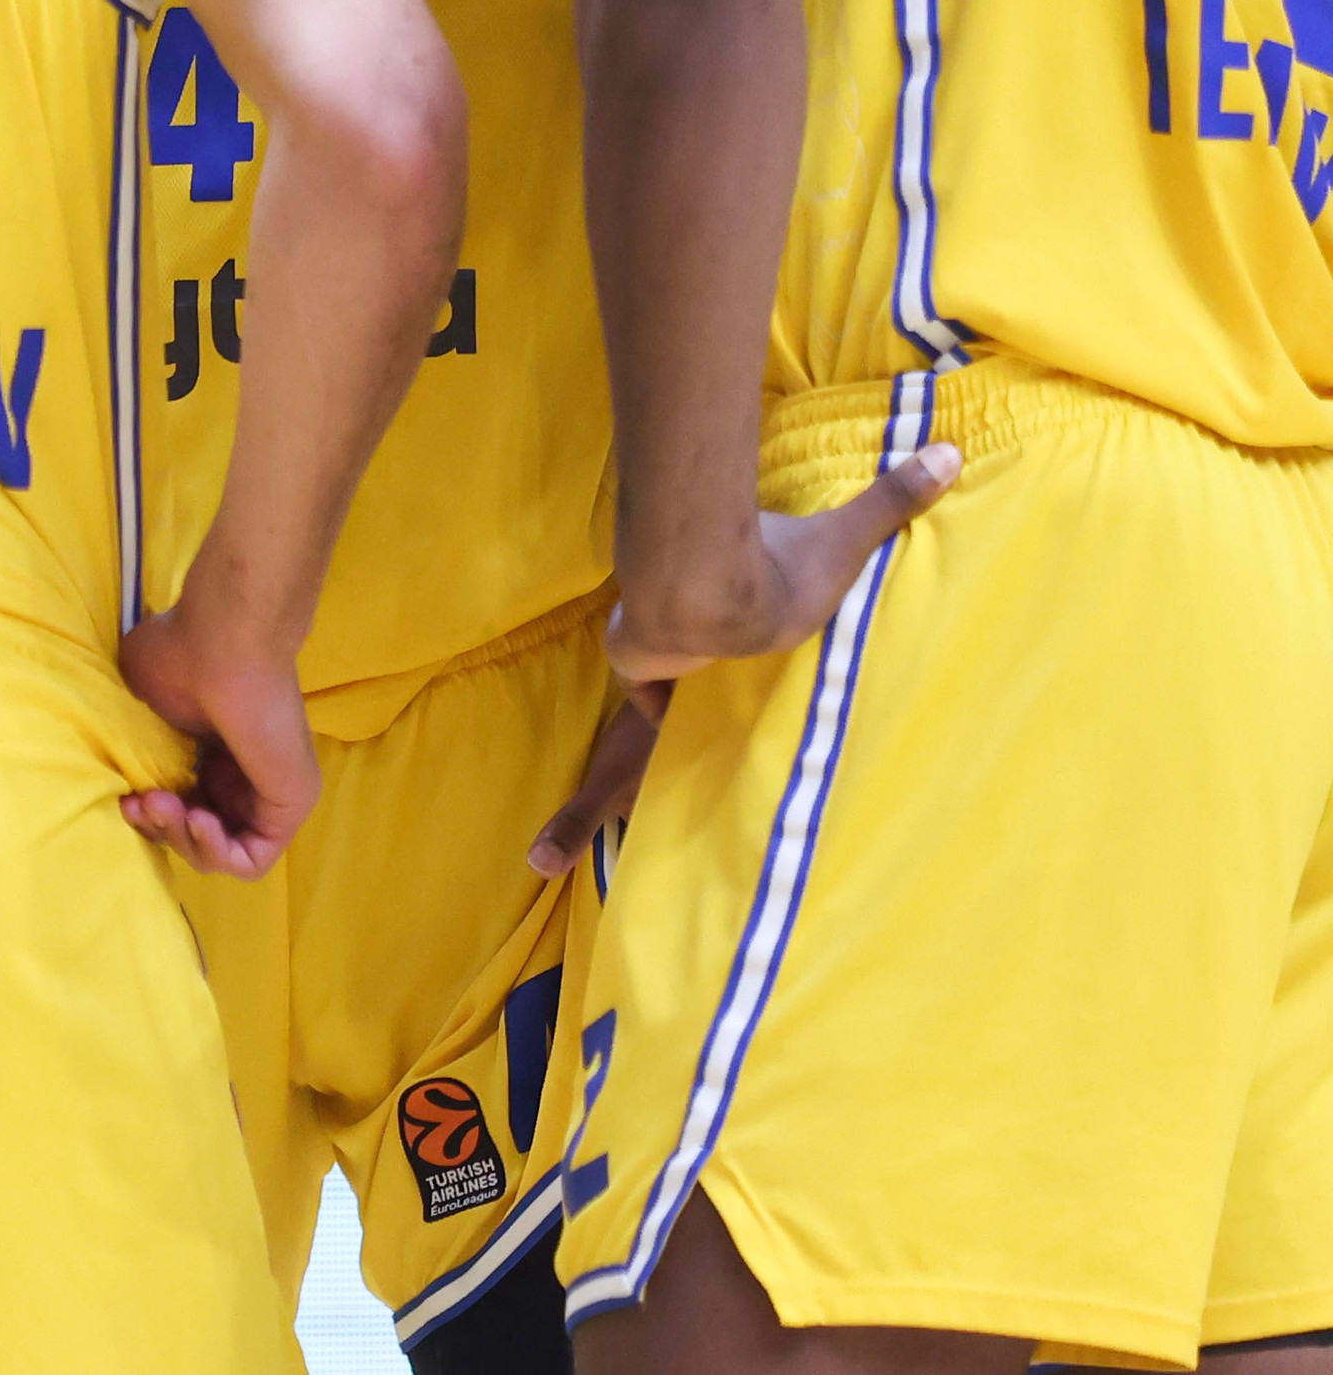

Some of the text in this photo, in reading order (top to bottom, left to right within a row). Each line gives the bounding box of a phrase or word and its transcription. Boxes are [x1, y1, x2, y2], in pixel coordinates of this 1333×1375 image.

[425, 1158, 496, 1190] TURKISH
[430, 1172, 499, 1205] AIRLINES
[430, 1188, 499, 1218] EuroLeague
